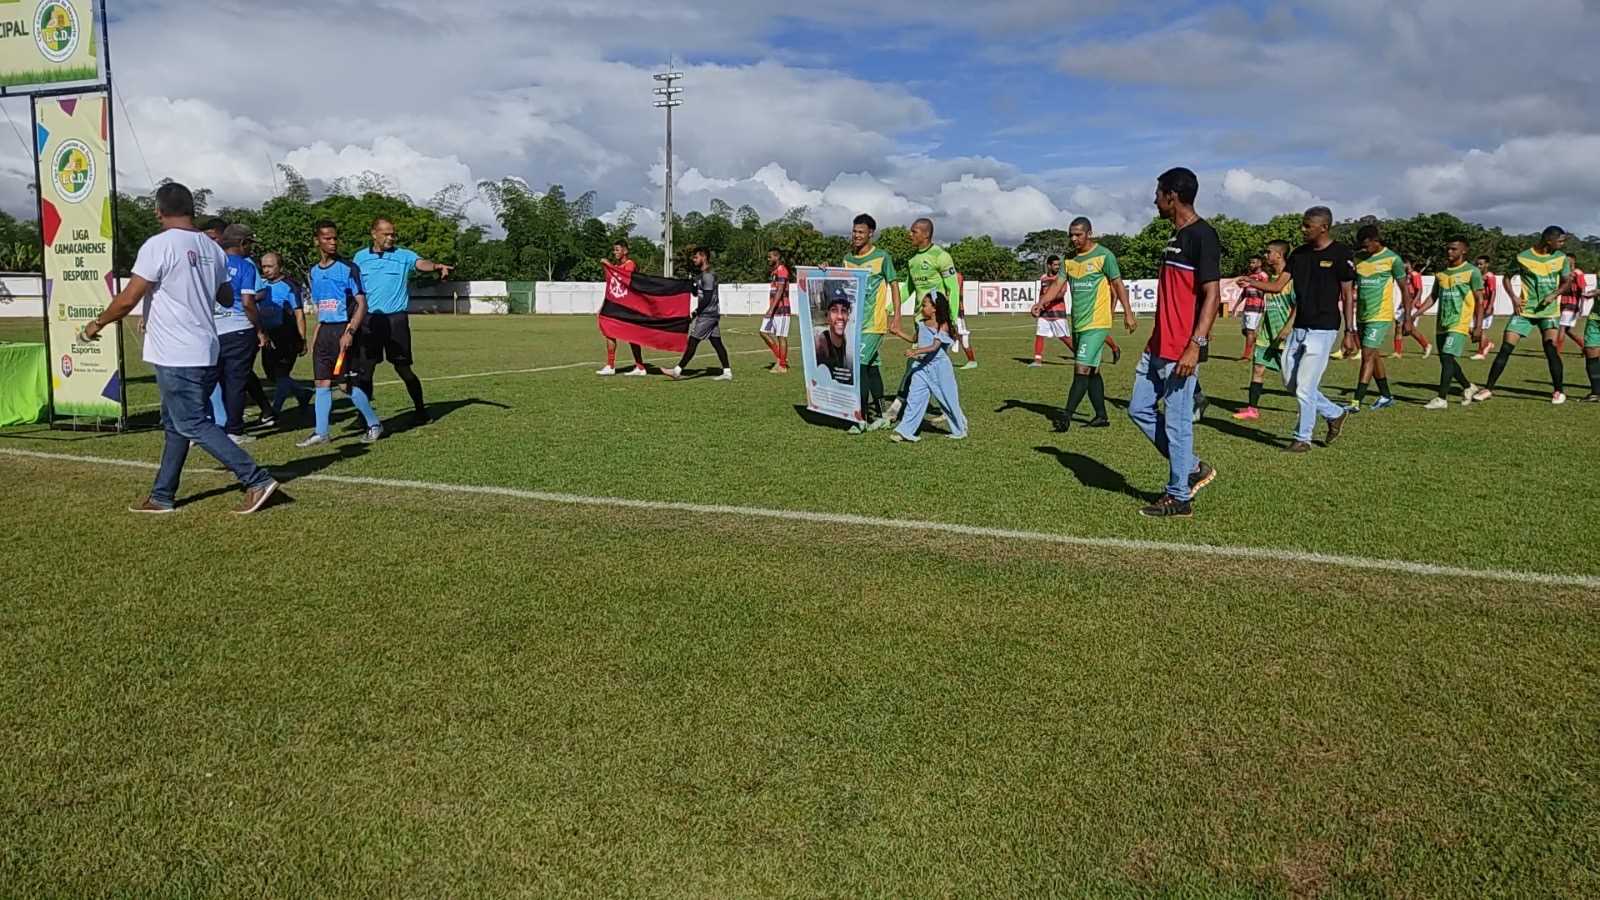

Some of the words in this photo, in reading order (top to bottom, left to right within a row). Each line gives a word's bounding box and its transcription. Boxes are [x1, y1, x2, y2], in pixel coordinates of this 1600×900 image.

[72, 229, 89, 241] LIGA
[54, 243, 106, 254] CAMACANENSE
[75, 256, 85, 268] DE
[63, 270, 99, 281] DESPORTO
[1001, 287, 1034, 302] REAL
[1125, 284, 1155, 300] te
[71, 347, 102, 356] Esportes
